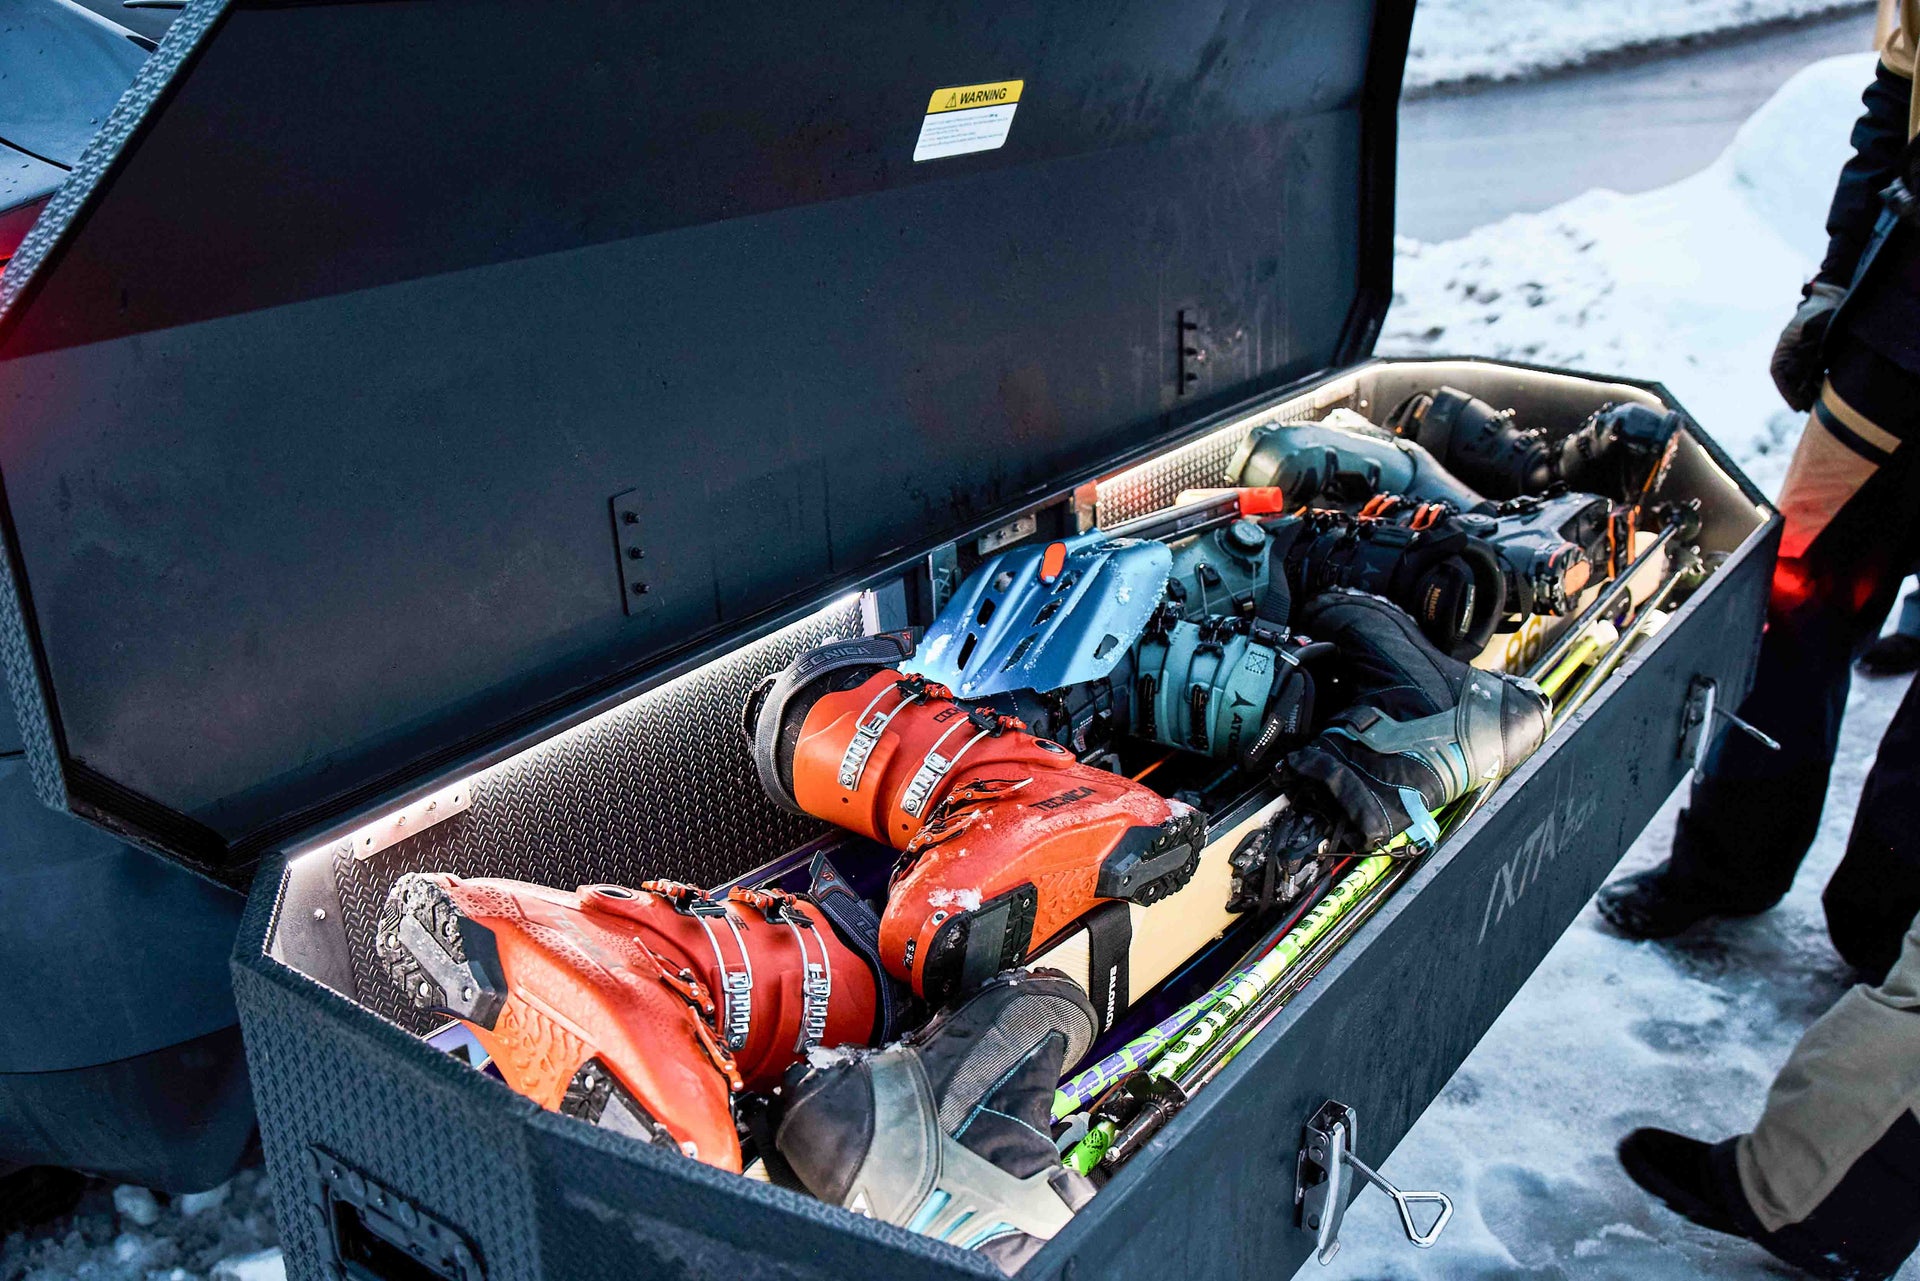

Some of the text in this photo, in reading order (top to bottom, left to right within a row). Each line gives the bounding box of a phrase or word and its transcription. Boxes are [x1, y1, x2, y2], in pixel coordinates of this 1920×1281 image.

[960, 88, 1007, 105] WARNING
[1028, 785, 1097, 811] TECNICA
[1103, 964, 1118, 1034] SALOMON
